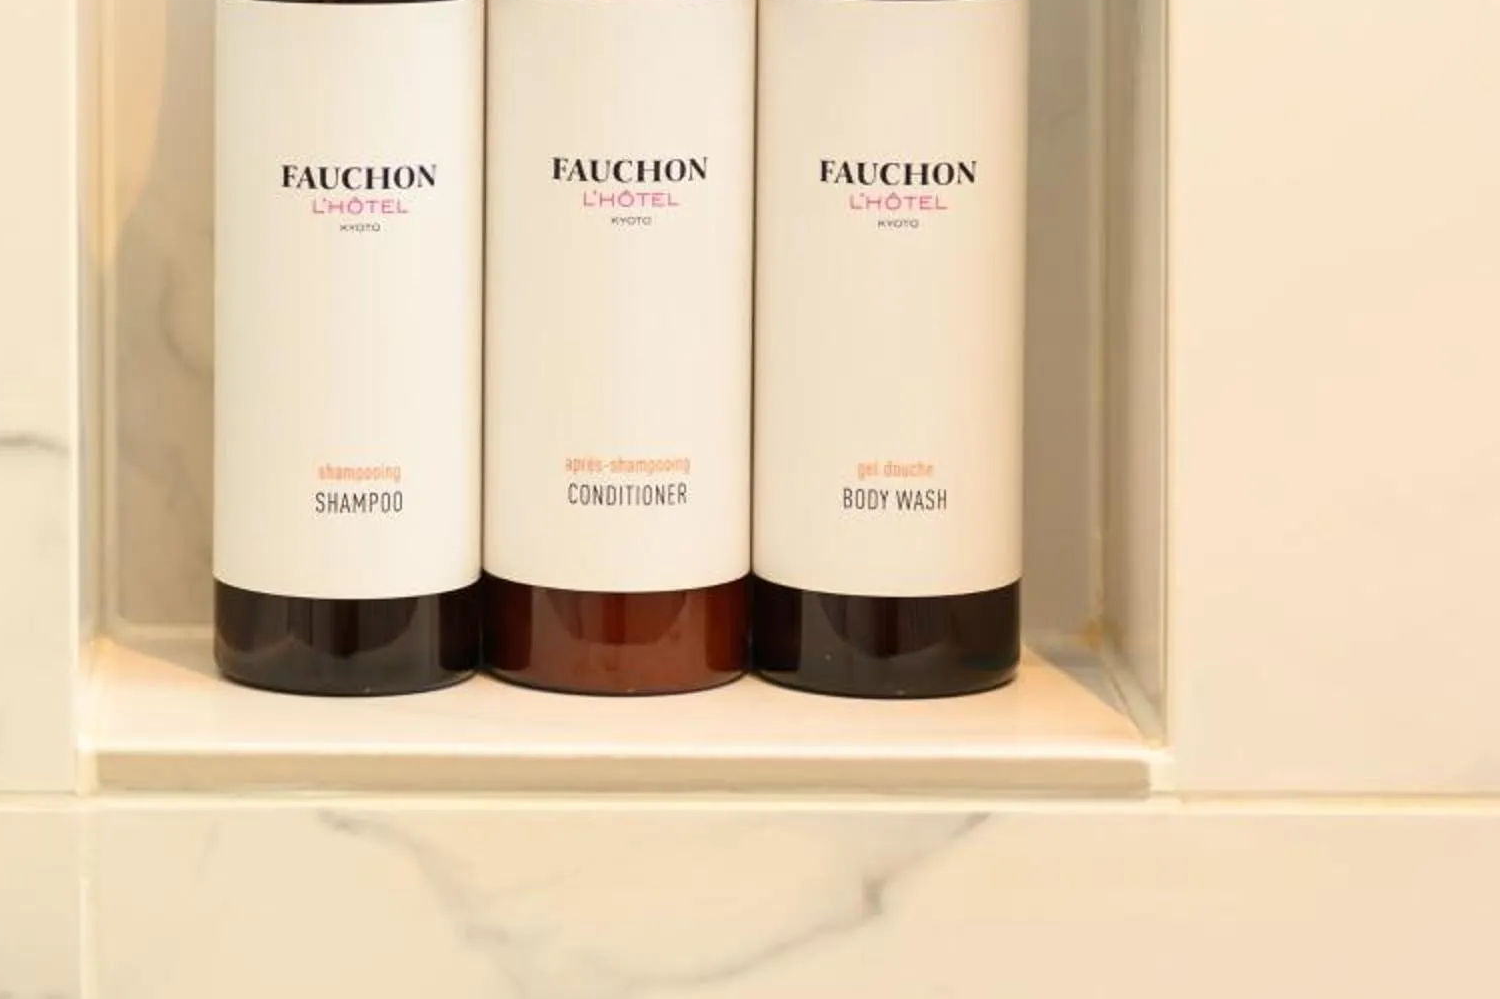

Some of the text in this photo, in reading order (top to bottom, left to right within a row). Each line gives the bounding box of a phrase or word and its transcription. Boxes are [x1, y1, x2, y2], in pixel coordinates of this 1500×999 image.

[281, 163, 437, 191] FAUCHON
[552, 156, 708, 184] FAUCHON
[820, 159, 977, 187] FAUCHON
[312, 196, 409, 215] L'HÔTEL
[583, 189, 680, 208] L'HÔTEL
[850, 192, 948, 211] L'HÔTEL
[339, 222, 381, 233] KYOTO
[611, 215, 653, 227] KYOTO
[877, 218, 920, 230] KYOTO
[315, 490, 404, 514] SHAMPOO
[567, 481, 689, 506] CONDITIONER
[843, 487, 947, 512] BODY WASH
